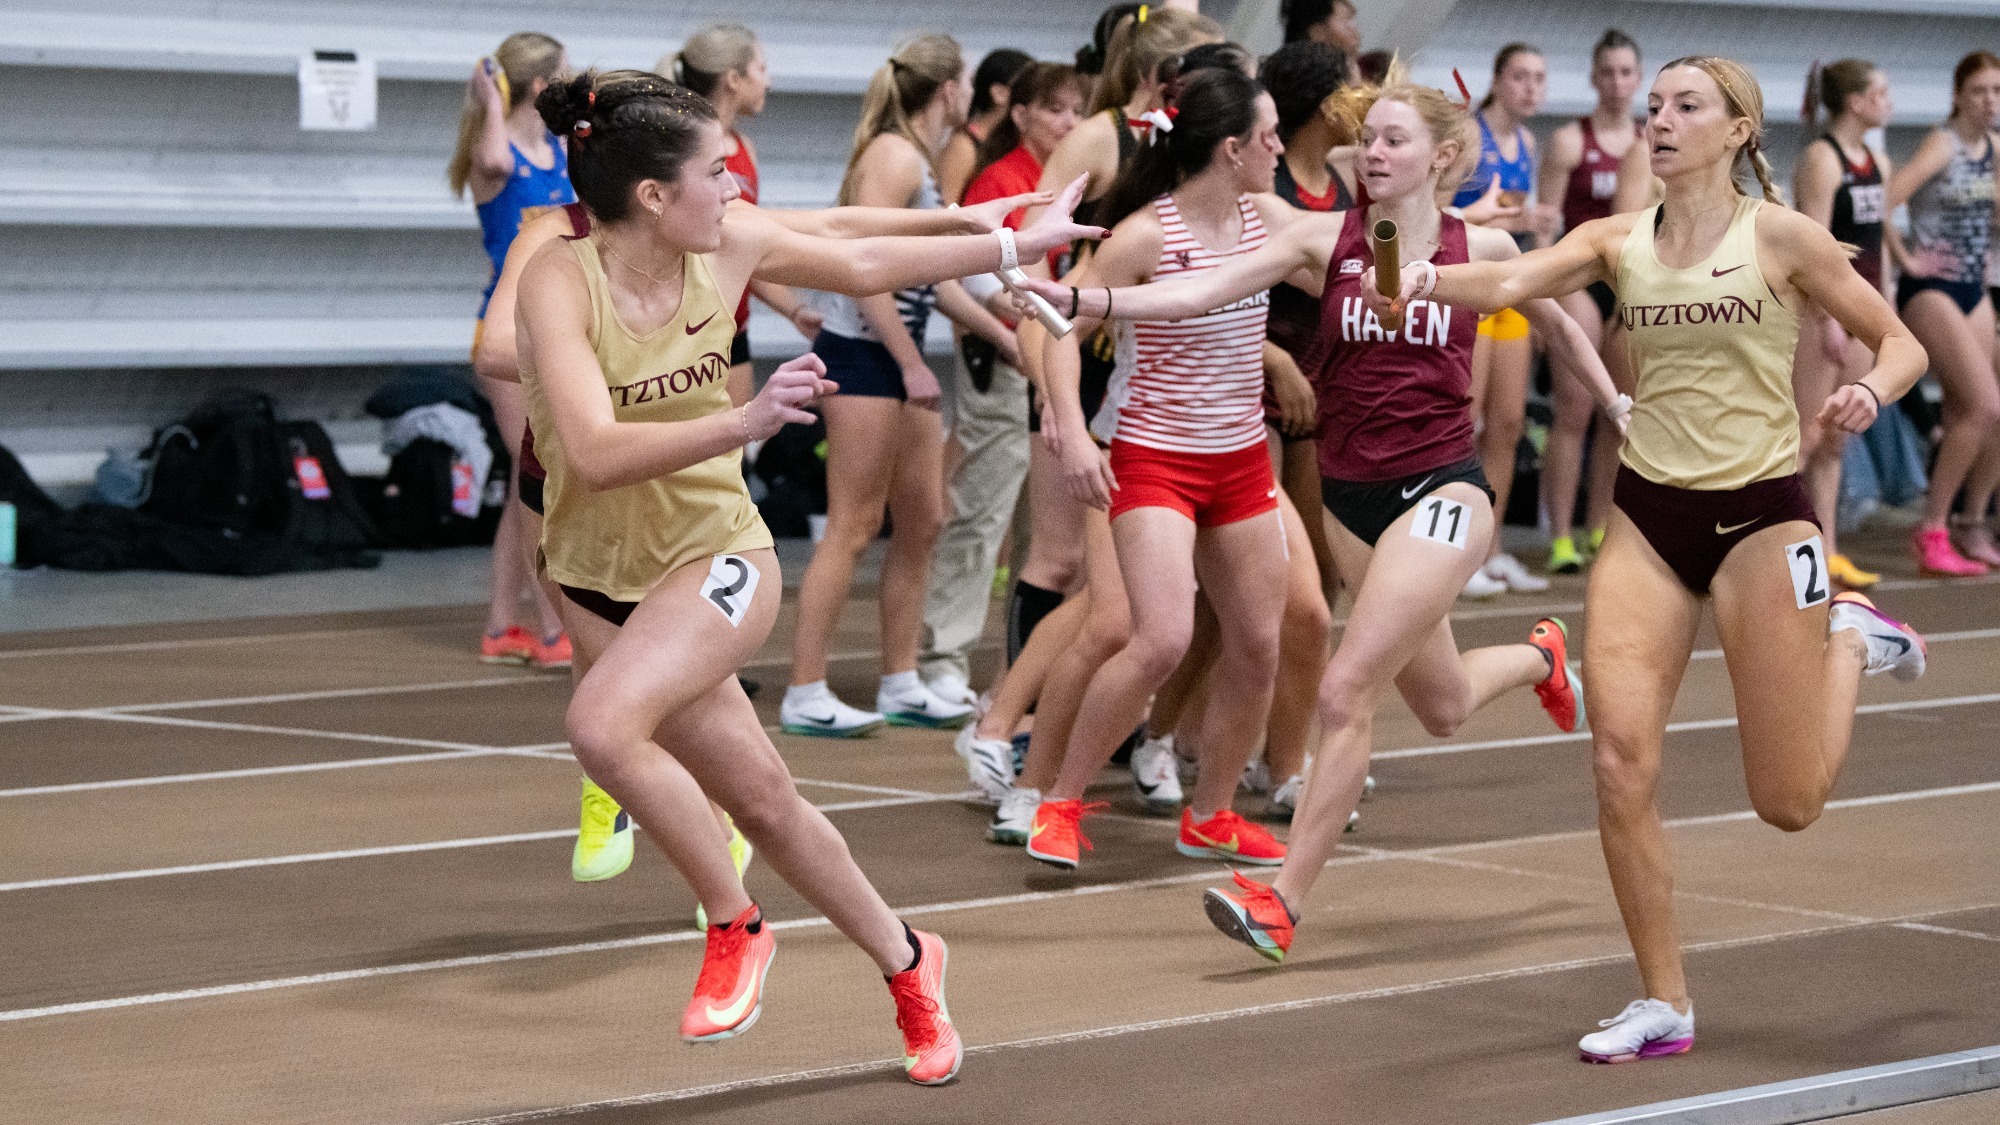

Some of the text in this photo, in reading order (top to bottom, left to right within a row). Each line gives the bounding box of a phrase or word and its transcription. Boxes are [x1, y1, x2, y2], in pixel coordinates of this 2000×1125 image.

[1341, 296, 1451, 347] HAEN
[608, 352, 730, 407] TZTOWN
[1428, 500, 1462, 543] 11
[709, 557, 748, 617] 2
[1796, 545, 1826, 604] 2
